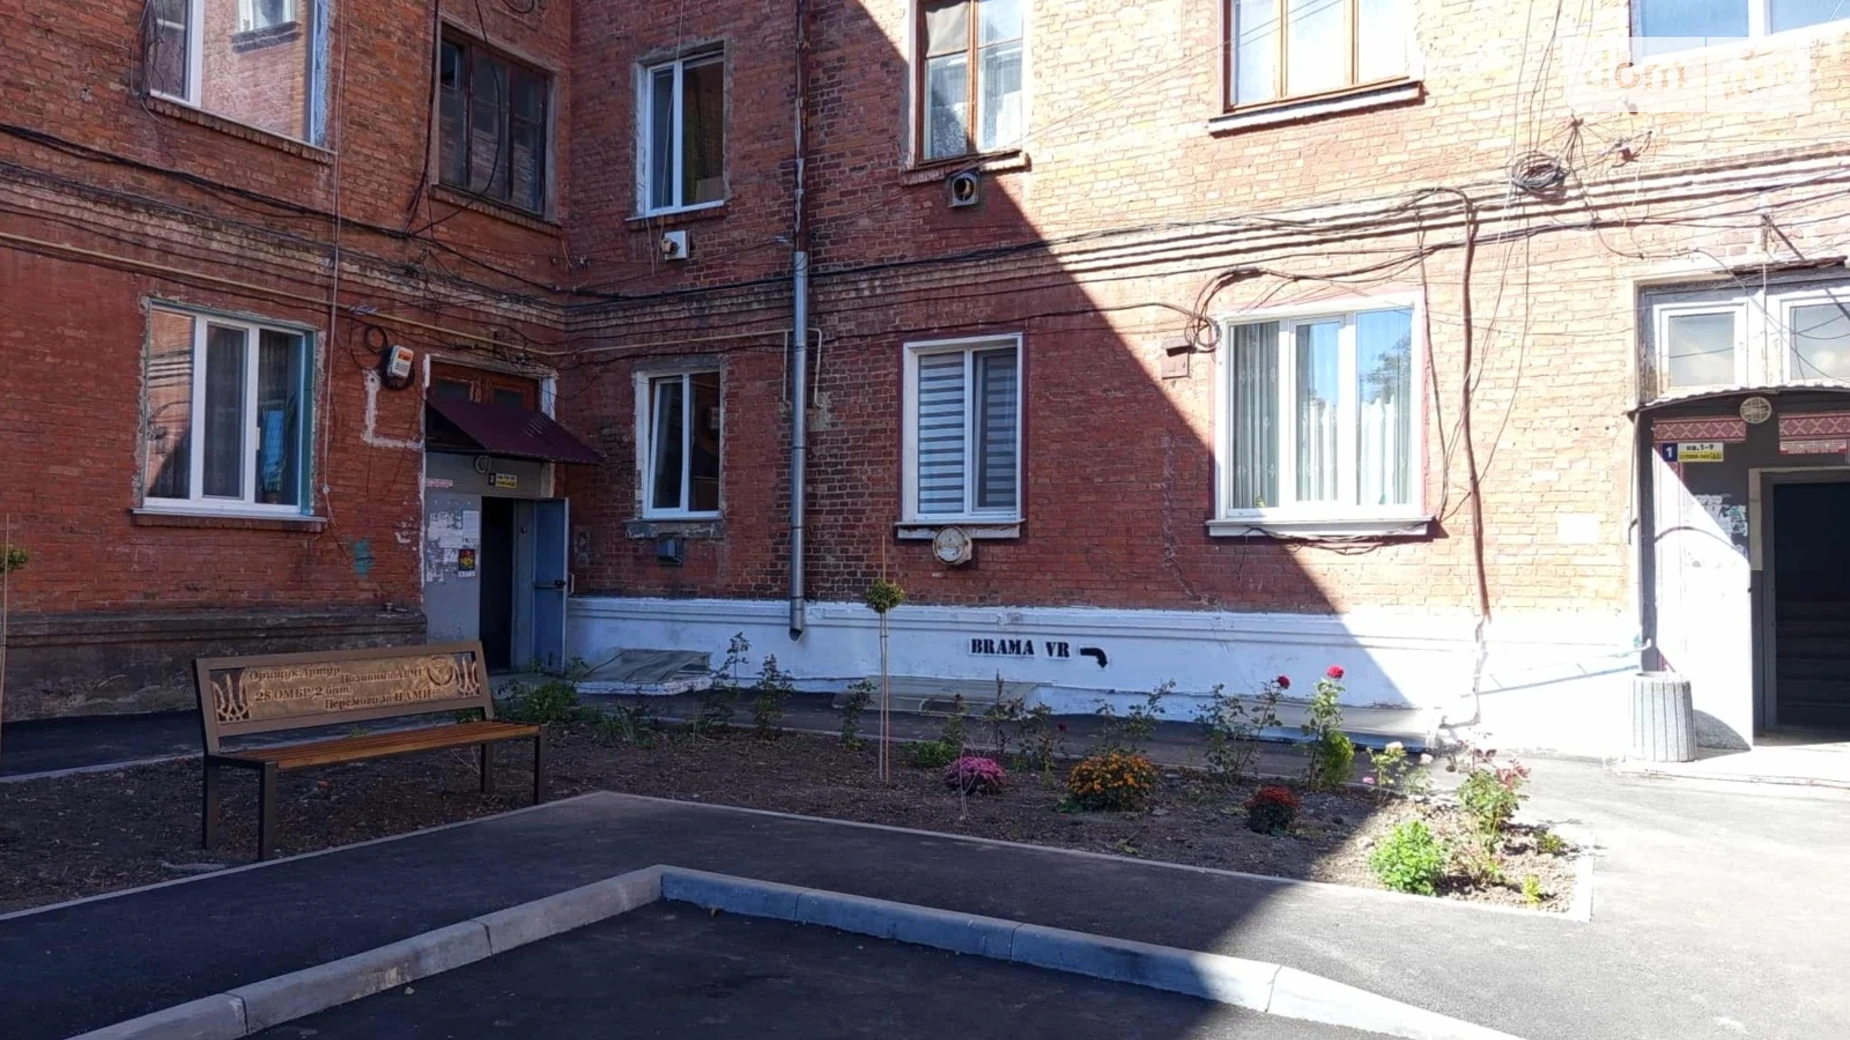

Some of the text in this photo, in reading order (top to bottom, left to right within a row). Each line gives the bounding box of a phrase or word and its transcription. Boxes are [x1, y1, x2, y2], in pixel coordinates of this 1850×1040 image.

[1665, 446, 1673, 458] 1
[971, 638, 1070, 658] BRAMA VR
[255, 690, 271, 702] 28
